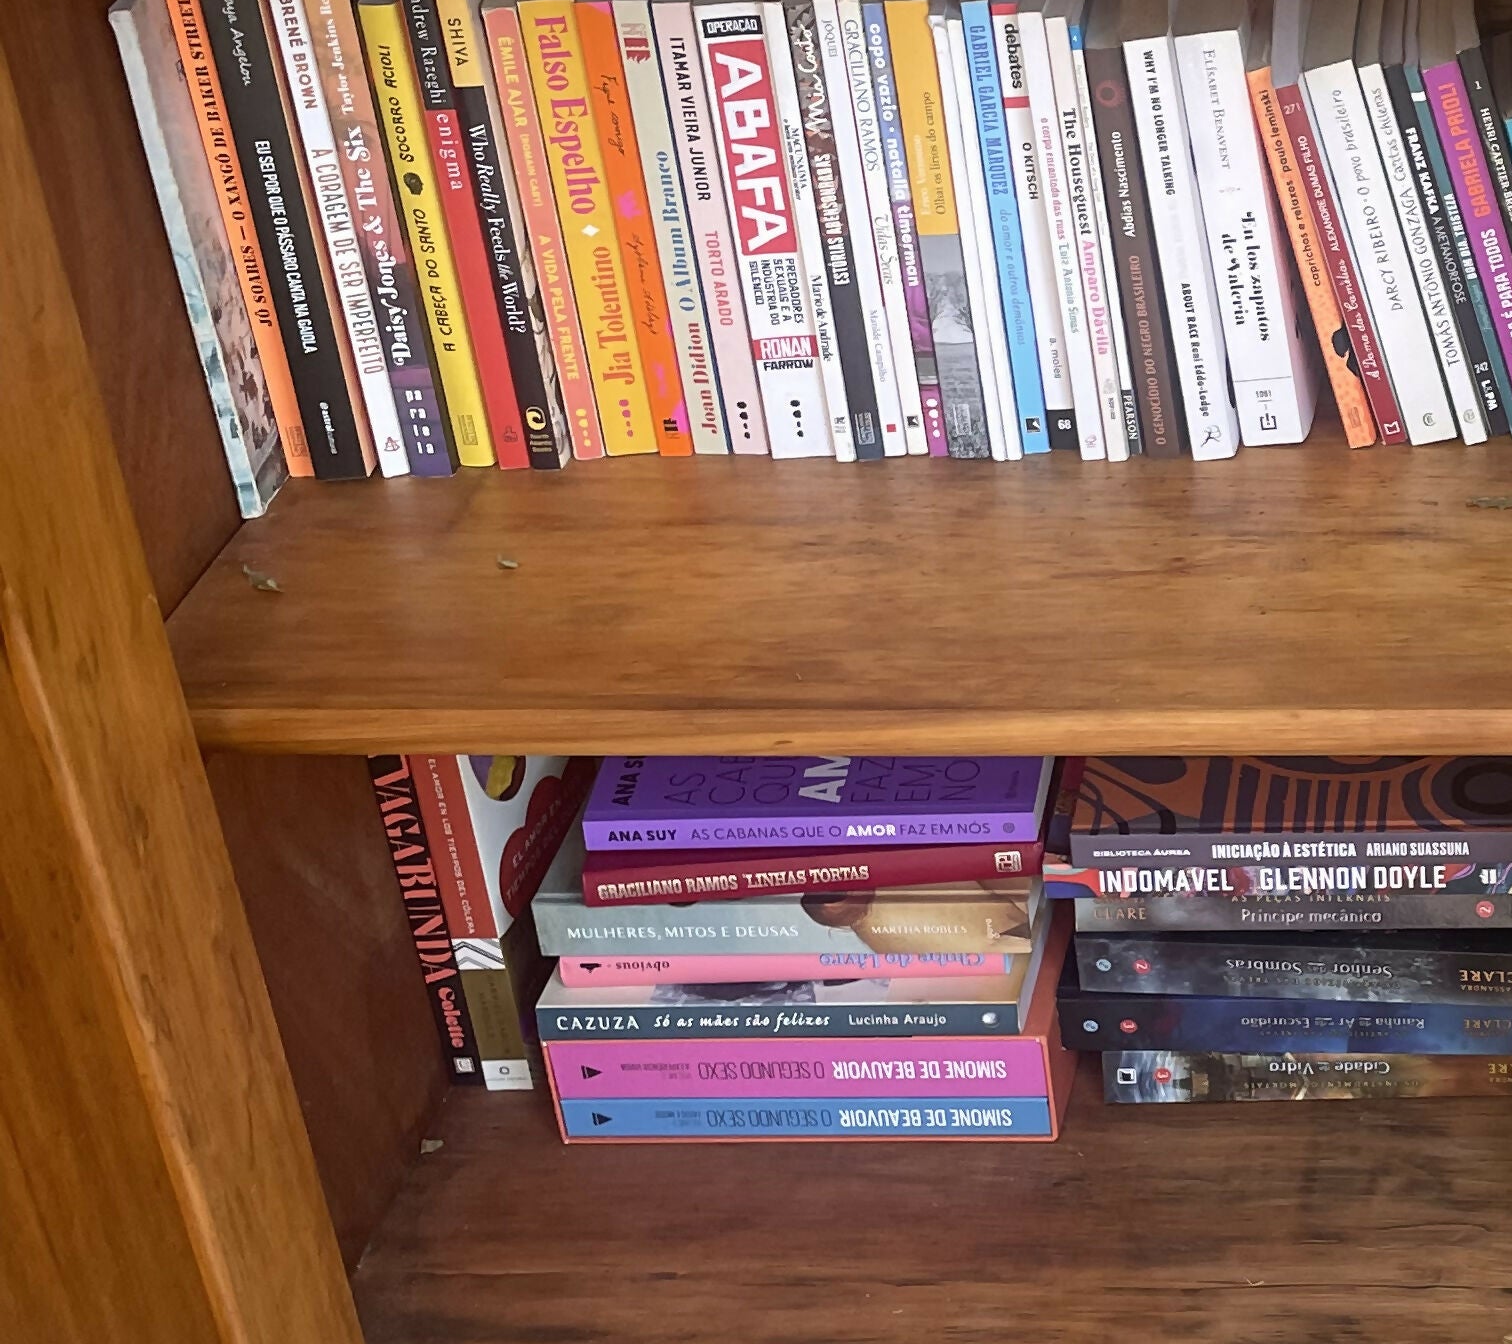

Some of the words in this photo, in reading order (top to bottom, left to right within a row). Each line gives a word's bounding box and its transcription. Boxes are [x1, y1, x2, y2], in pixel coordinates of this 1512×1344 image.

[230, 27, 252, 87] Angelou
[447, 18, 469, 67] SHIVA
[497, 36, 519, 84] ÉMILE
[534, 15, 573, 92] Falso
[1004, 23, 1023, 89] debates
[1143, 50, 1157, 73] WHY
[292, 52, 318, 110] BROWN
[378, 44, 397, 88] ACIOLI
[421, 46, 447, 105] Razeghi
[669, 37, 692, 91] ITAMAR
[868, 23, 886, 69] copo
[877, 74, 897, 122] vazio
[195, 65, 221, 122] BAKER
[844, 19, 871, 113] GRACILIANO
[859, 118, 879, 172] RAMOS
[1147, 77, 1159, 94] I'M
[1150, 97, 1162, 111] NO
[507, 88, 528, 128] AJAR
[680, 95, 700, 143] VIEIRA
[1063, 107, 1077, 139] The
[1258, 89, 1281, 138] leminski
[1438, 82, 1466, 137] PRIOLI
[210, 127, 227, 148] DE
[387, 96, 414, 162] SOCORRO
[1022, 142, 1032, 152] O
[1153, 114, 1169, 152] LONGER
[1213, 109, 1230, 169] BENAVENT
[1297, 135, 1314, 162] FILHO
[311, 148, 333, 158] A
[436, 113, 463, 190] enigma
[550, 96, 601, 215] Espelho
[715, 52, 788, 253] ABAFA
[1110, 131, 1130, 197] Nascimento
[1275, 140, 1292, 172] paulo
[1405, 127, 1428, 170] FRANZ
[1419, 172, 1440, 214] KAFKA
[217, 153, 242, 206] XANGÔ
[689, 147, 711, 201] JUNIOR
[1023, 156, 1039, 200] KITSCH
[1068, 143, 1092, 236] Houseguest
[1160, 155, 1176, 195] TALKING
[1306, 164, 1324, 199] DUMAS
[1455, 138, 1492, 219] GABRIELA
[233, 211, 245, 221] O
[315, 164, 350, 233] CORAGEM
[885, 137, 909, 201] natalia
[897, 205, 920, 287] timerman
[413, 208, 436, 253] SANTO
[1119, 199, 1136, 238] Abdias
[1315, 197, 1341, 252] ALEXANDRE
[1363, 205, 1390, 265] RIBEIRO
[1400, 188, 1428, 255] GONZAGA
[332, 238, 356, 257] DE
[704, 231, 724, 277] TORTO
[1302, 232, 1321, 286] caprichos
[240, 245, 268, 305] SOARES
[337, 261, 363, 288] SER
[428, 259, 438, 278] DO
[1417, 259, 1446, 316] ANTÔNIO
[592, 246, 628, 349] Tolentino
[713, 281, 734, 326] ARADO
[1379, 268, 1404, 311] DARCY
[254, 309, 272, 327] JÔ
[431, 285, 453, 337] CABEÇA
[346, 291, 385, 375] IMPERFEITO
[444, 343, 456, 351] A
[760, 337, 812, 360] RONAN
[1435, 318, 1460, 367] TOMÁS
[602, 351, 636, 386] Jia
[687, 322, 711, 384] Didion
[763, 359, 814, 371] FARROW
[700, 389, 717, 435] Joan
[1123, 395, 1138, 440] PEARSON
[664, 773, 706, 805] AS
[608, 830, 642, 842] ANA
[646, 829, 677, 841] SUY
[691, 828, 710, 840] AS
[714, 826, 788, 840] CABANAS
[792, 825, 824, 839] QUE
[829, 825, 842, 837] O
[846, 824, 897, 837] AMOR
[900, 823, 926, 836] FAZ
[931, 822, 953, 835] EM
[957, 820, 991, 834] NÓS
[1366, 842, 1407, 857] ARIANO
[1410, 841, 1470, 856] SUASSUNA
[374, 757, 457, 984] VAGABUNDA
[1093, 848, 1150, 857] BIBLIOTECA
[597, 878, 683, 901] GRACILIANO
[685, 874, 738, 893] RAMOS
[1260, 866, 1369, 890] GLENNON
[1373, 865, 1447, 889] DOYLE
[566, 925, 662, 941] MULHERES,
[665, 924, 716, 939] MITOS
[721, 924, 731, 938] E
[735, 923, 799, 938] DEUSAS
[871, 923, 919, 935] MARTHA
[923, 923, 968, 935] ROBLES
[1093, 906, 1147, 921] CLARE
[1225, 958, 1303, 975] Sombras
[1333, 961, 1393, 979] Senhor
[437, 986, 465, 1049] Colette
[556, 1015, 640, 1032] CAZUZA
[848, 1013, 899, 1026] Lucinha
[903, 1013, 948, 1030] Araujo
[1462, 1018, 1512, 1030] CLARE
[698, 1062, 737, 1080] SEXO
[740, 1062, 811, 1079] SEGUNDO
[813, 1062, 825, 1078] O
[831, 1060, 916, 1079] BEAUVOIR
[919, 1061, 941, 1078] DE
[946, 1060, 1007, 1079] SIMONE
[1269, 1060, 1313, 1074] Vidro
[1334, 1061, 1391, 1075] Cidade
[706, 1109, 746, 1129] SEXO
[747, 1109, 818, 1128] SEGUNDO
[820, 1109, 832, 1127] O
[838, 1108, 921, 1127] BEAUVOIR
[924, 1109, 946, 1127] DE
[950, 1108, 1013, 1127] SIMONE
